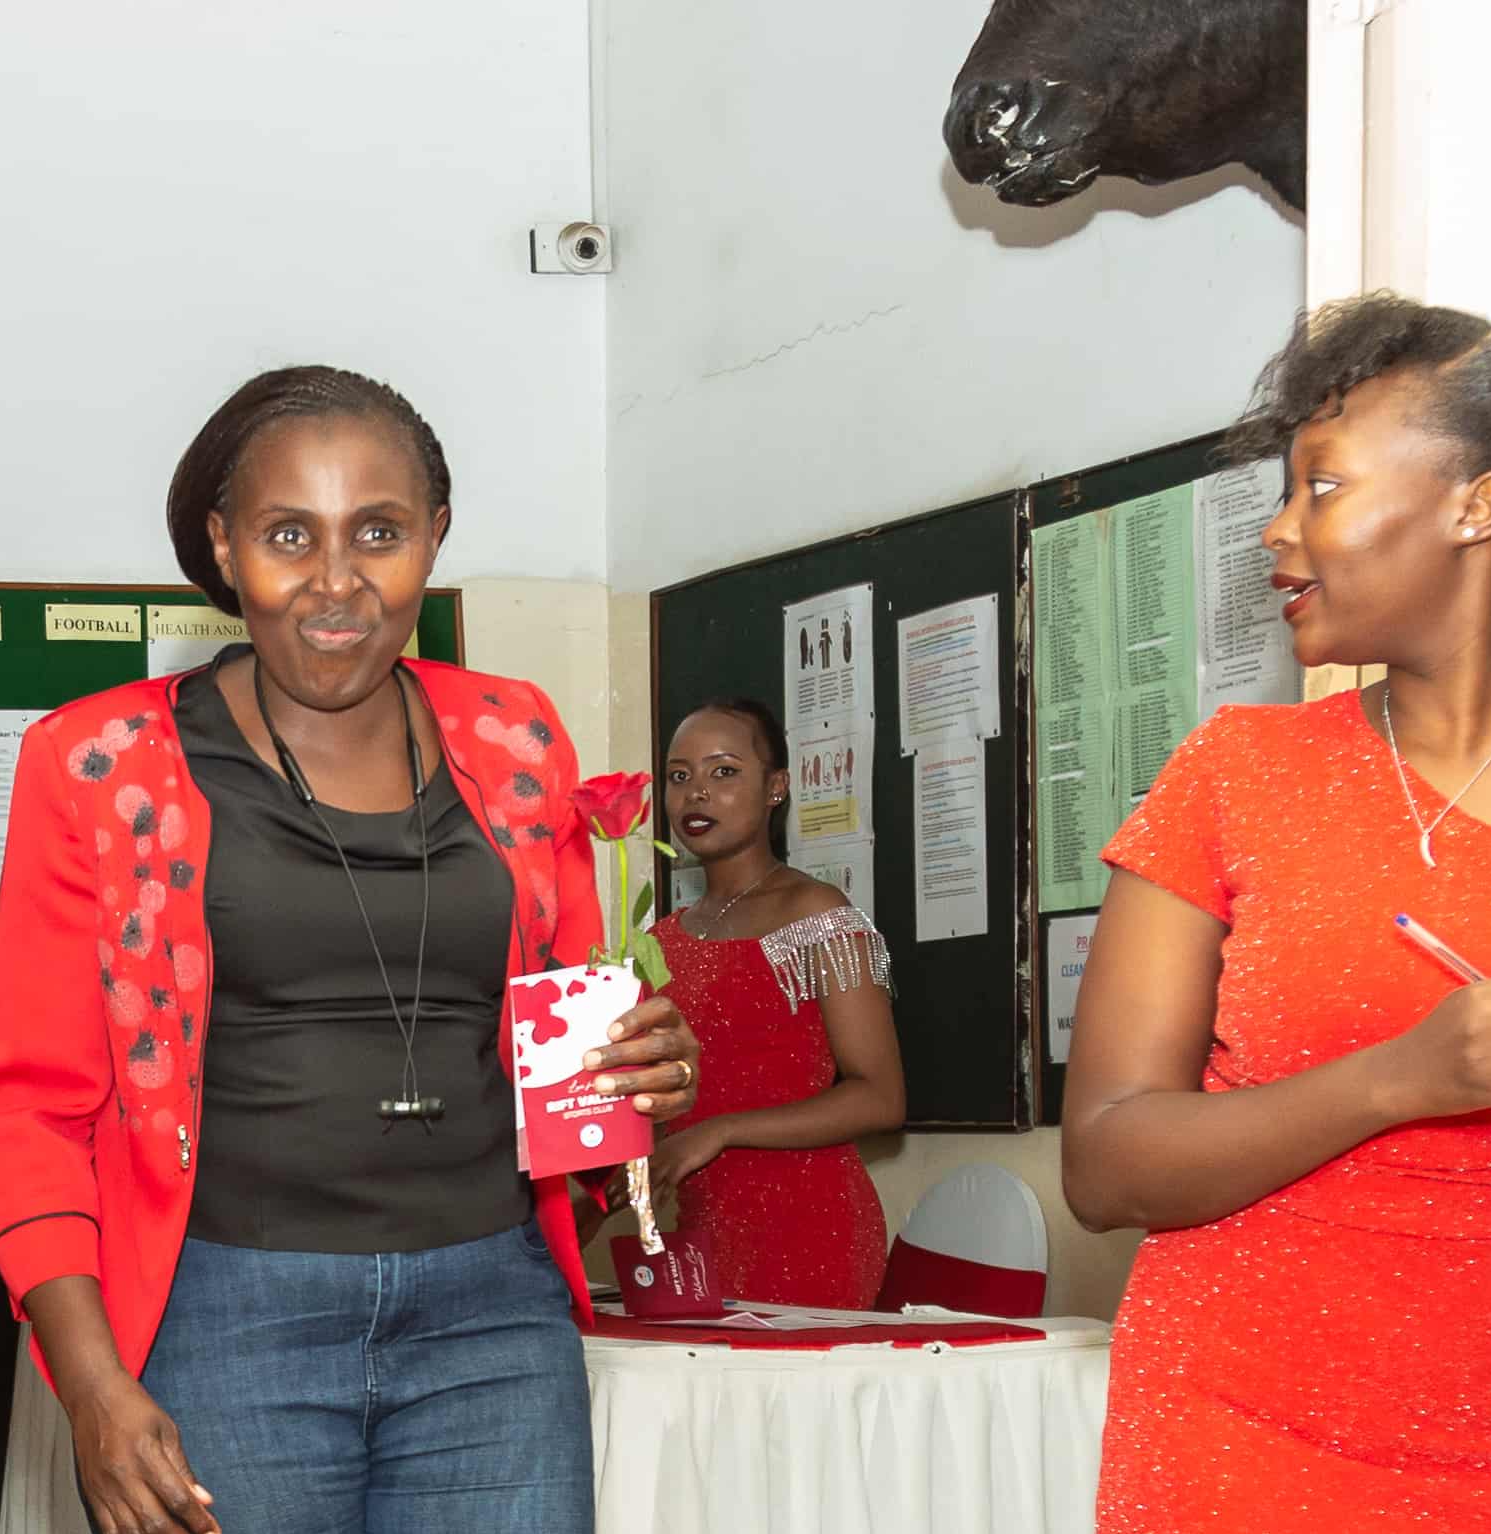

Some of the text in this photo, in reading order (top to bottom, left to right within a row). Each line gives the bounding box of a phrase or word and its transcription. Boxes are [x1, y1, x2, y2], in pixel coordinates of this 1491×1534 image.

[54, 617, 135, 634] FOOTBALL
[155, 621, 244, 637] HEALTH AND
